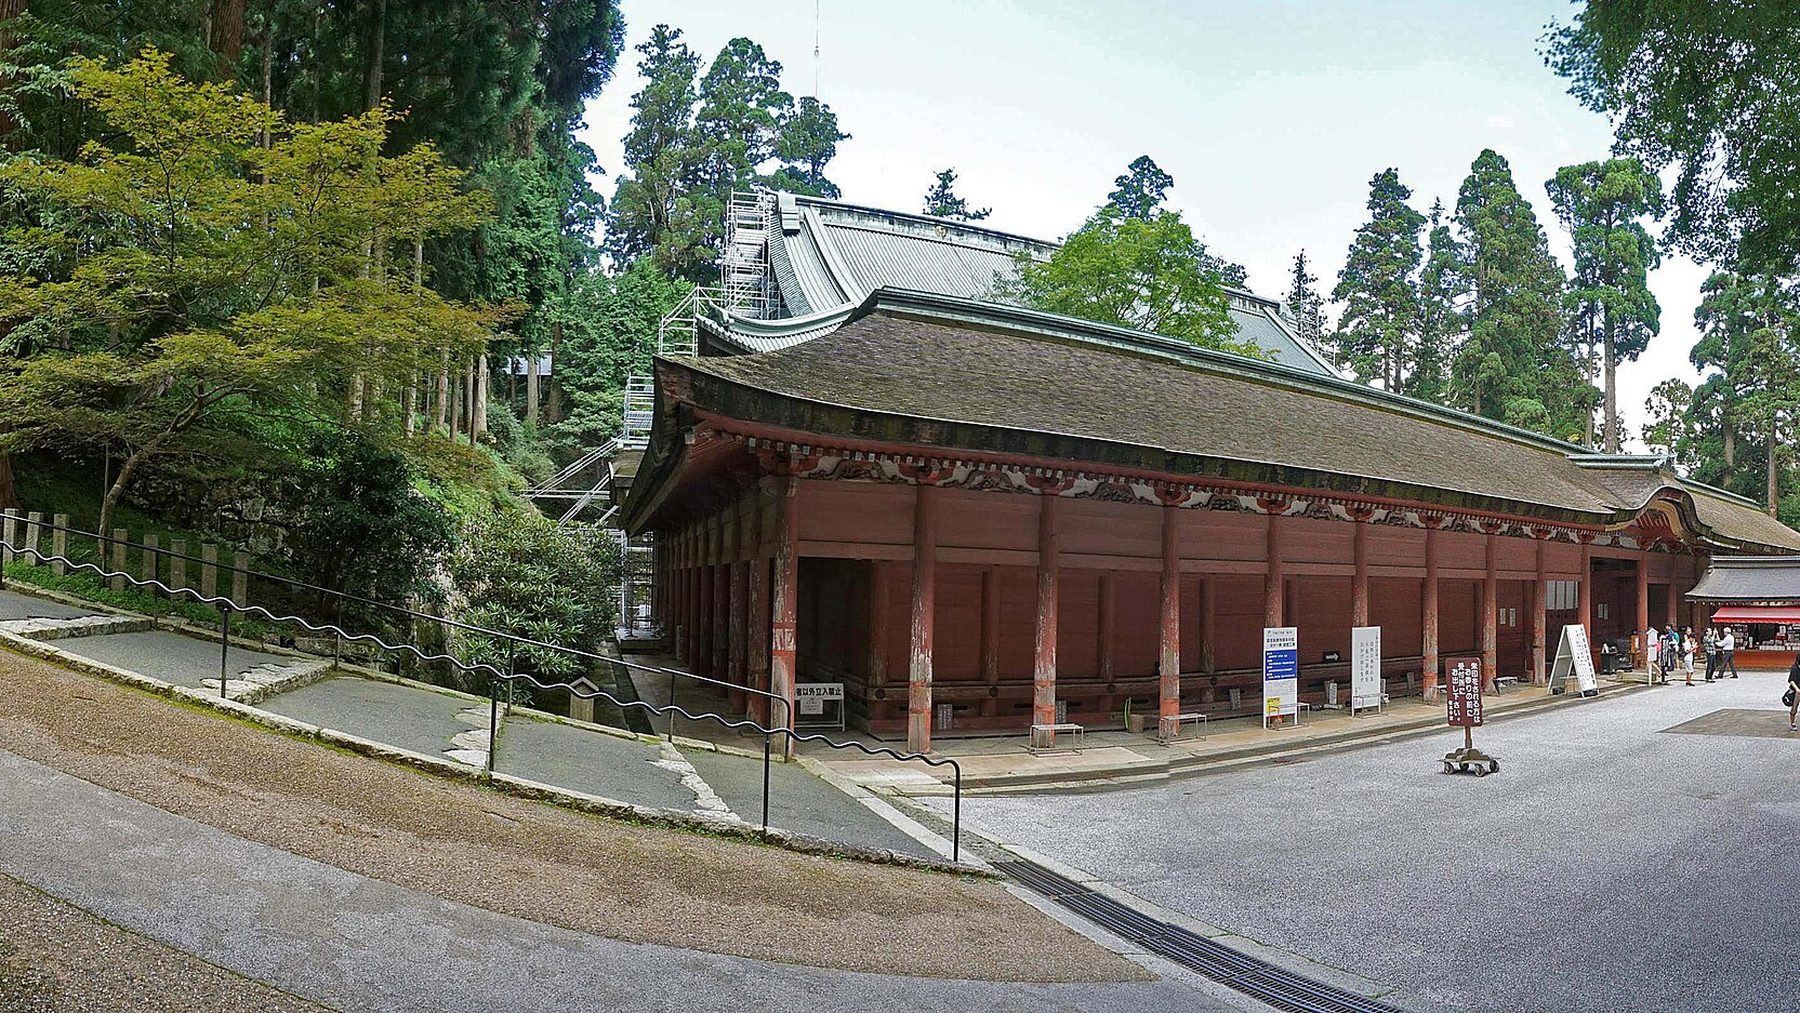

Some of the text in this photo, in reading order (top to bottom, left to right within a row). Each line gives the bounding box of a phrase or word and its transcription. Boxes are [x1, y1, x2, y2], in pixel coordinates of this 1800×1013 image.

[795, 687, 842, 697] 者以外立入禁止
